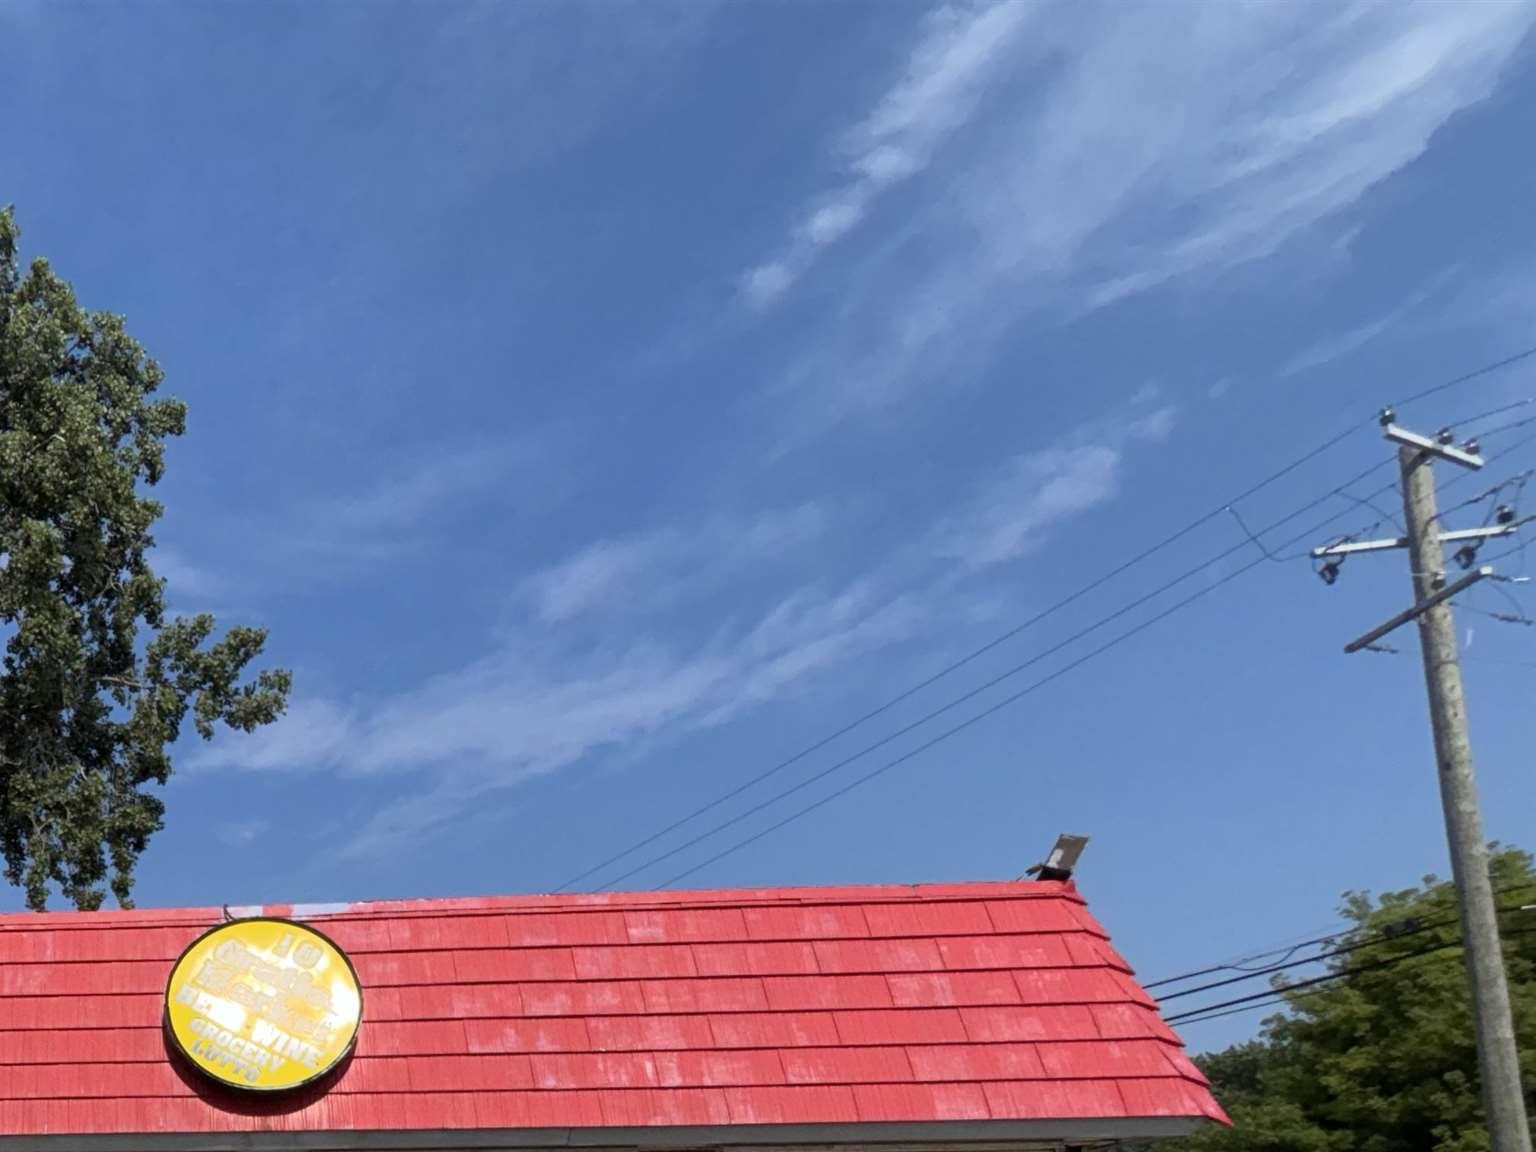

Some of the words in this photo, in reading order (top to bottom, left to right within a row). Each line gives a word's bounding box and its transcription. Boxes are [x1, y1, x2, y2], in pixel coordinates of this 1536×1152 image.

[190, 1018, 285, 1072] GROCERY
[191, 1041, 261, 1081] LOTTO
[252, 1019, 322, 1068] WINE
